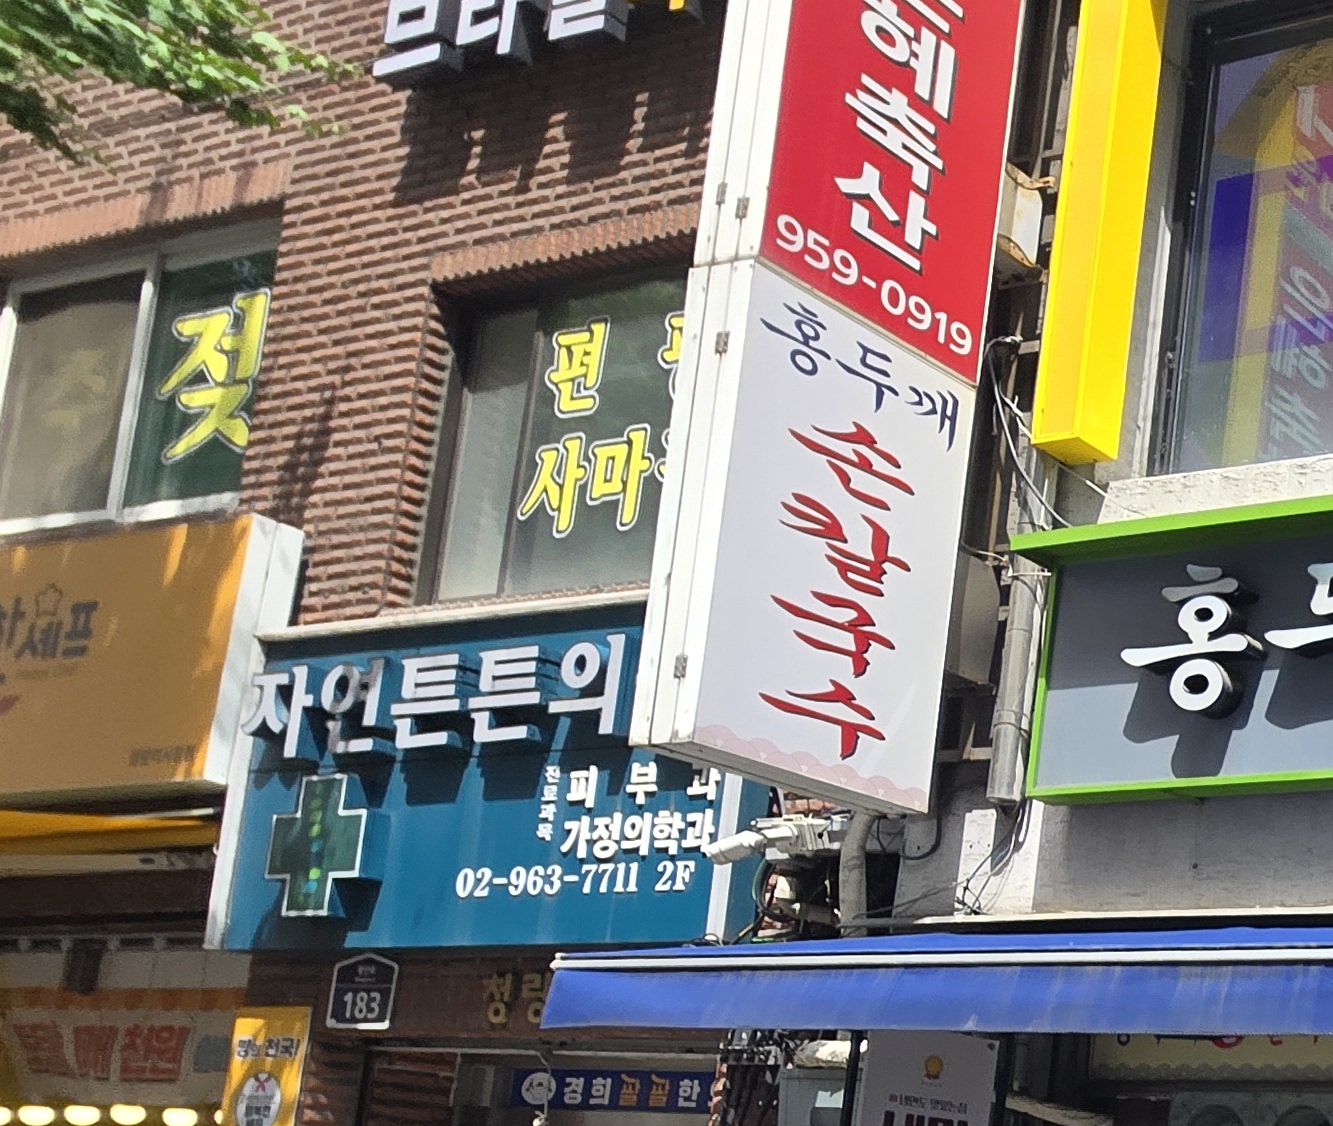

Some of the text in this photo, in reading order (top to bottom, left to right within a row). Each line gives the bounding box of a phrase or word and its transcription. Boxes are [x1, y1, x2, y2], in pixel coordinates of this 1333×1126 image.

[775, 214, 973, 356] 959-0919
[759, 300, 961, 452] 홍두깨
[517, 423, 675, 537] 사마
[241, 633, 627, 759] 자연튼튼의
[454, 858, 697, 898] 02-963-7711 2F
[558, 807, 718, 861] 가정의학과
[343, 991, 382, 1020] 183
